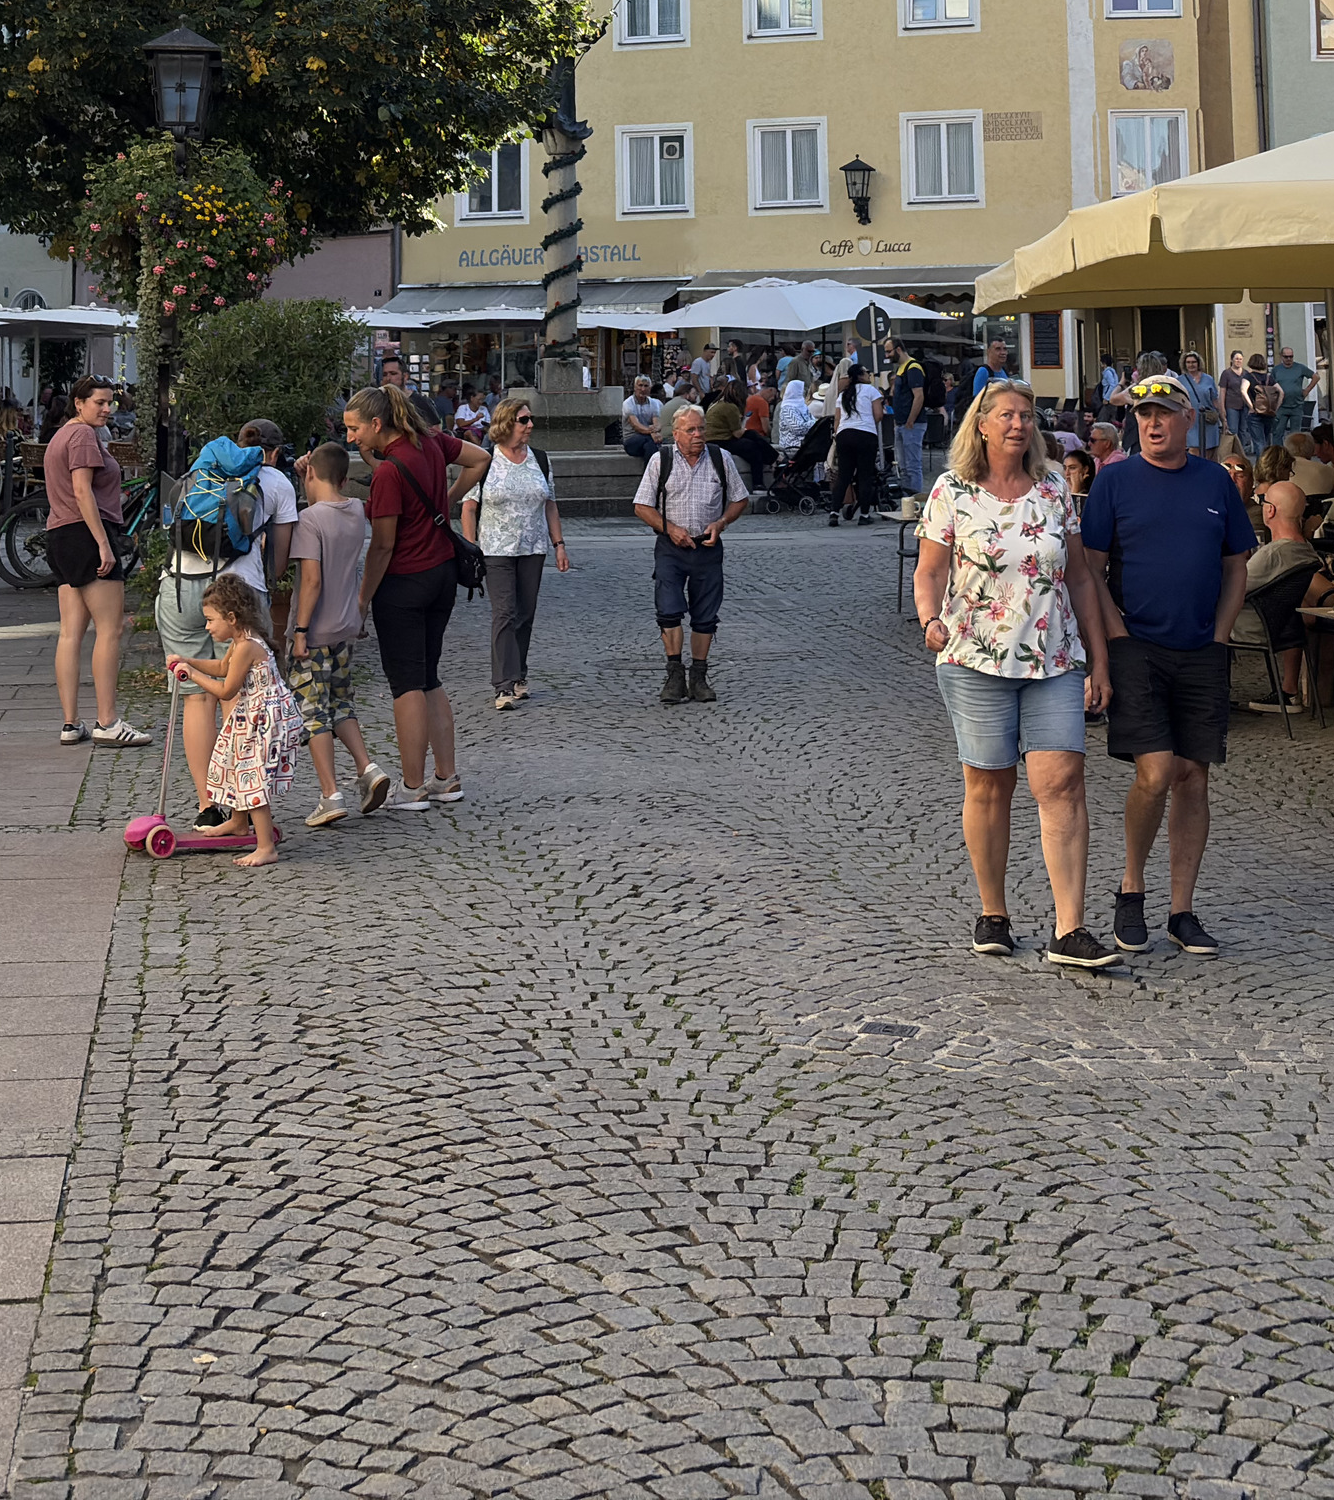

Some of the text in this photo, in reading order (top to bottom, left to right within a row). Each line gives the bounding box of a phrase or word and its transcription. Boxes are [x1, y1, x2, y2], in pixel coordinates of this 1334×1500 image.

[875, 240, 912, 253] Lucca
[458, 244, 641, 268] ALLGÄUER HSTALL
